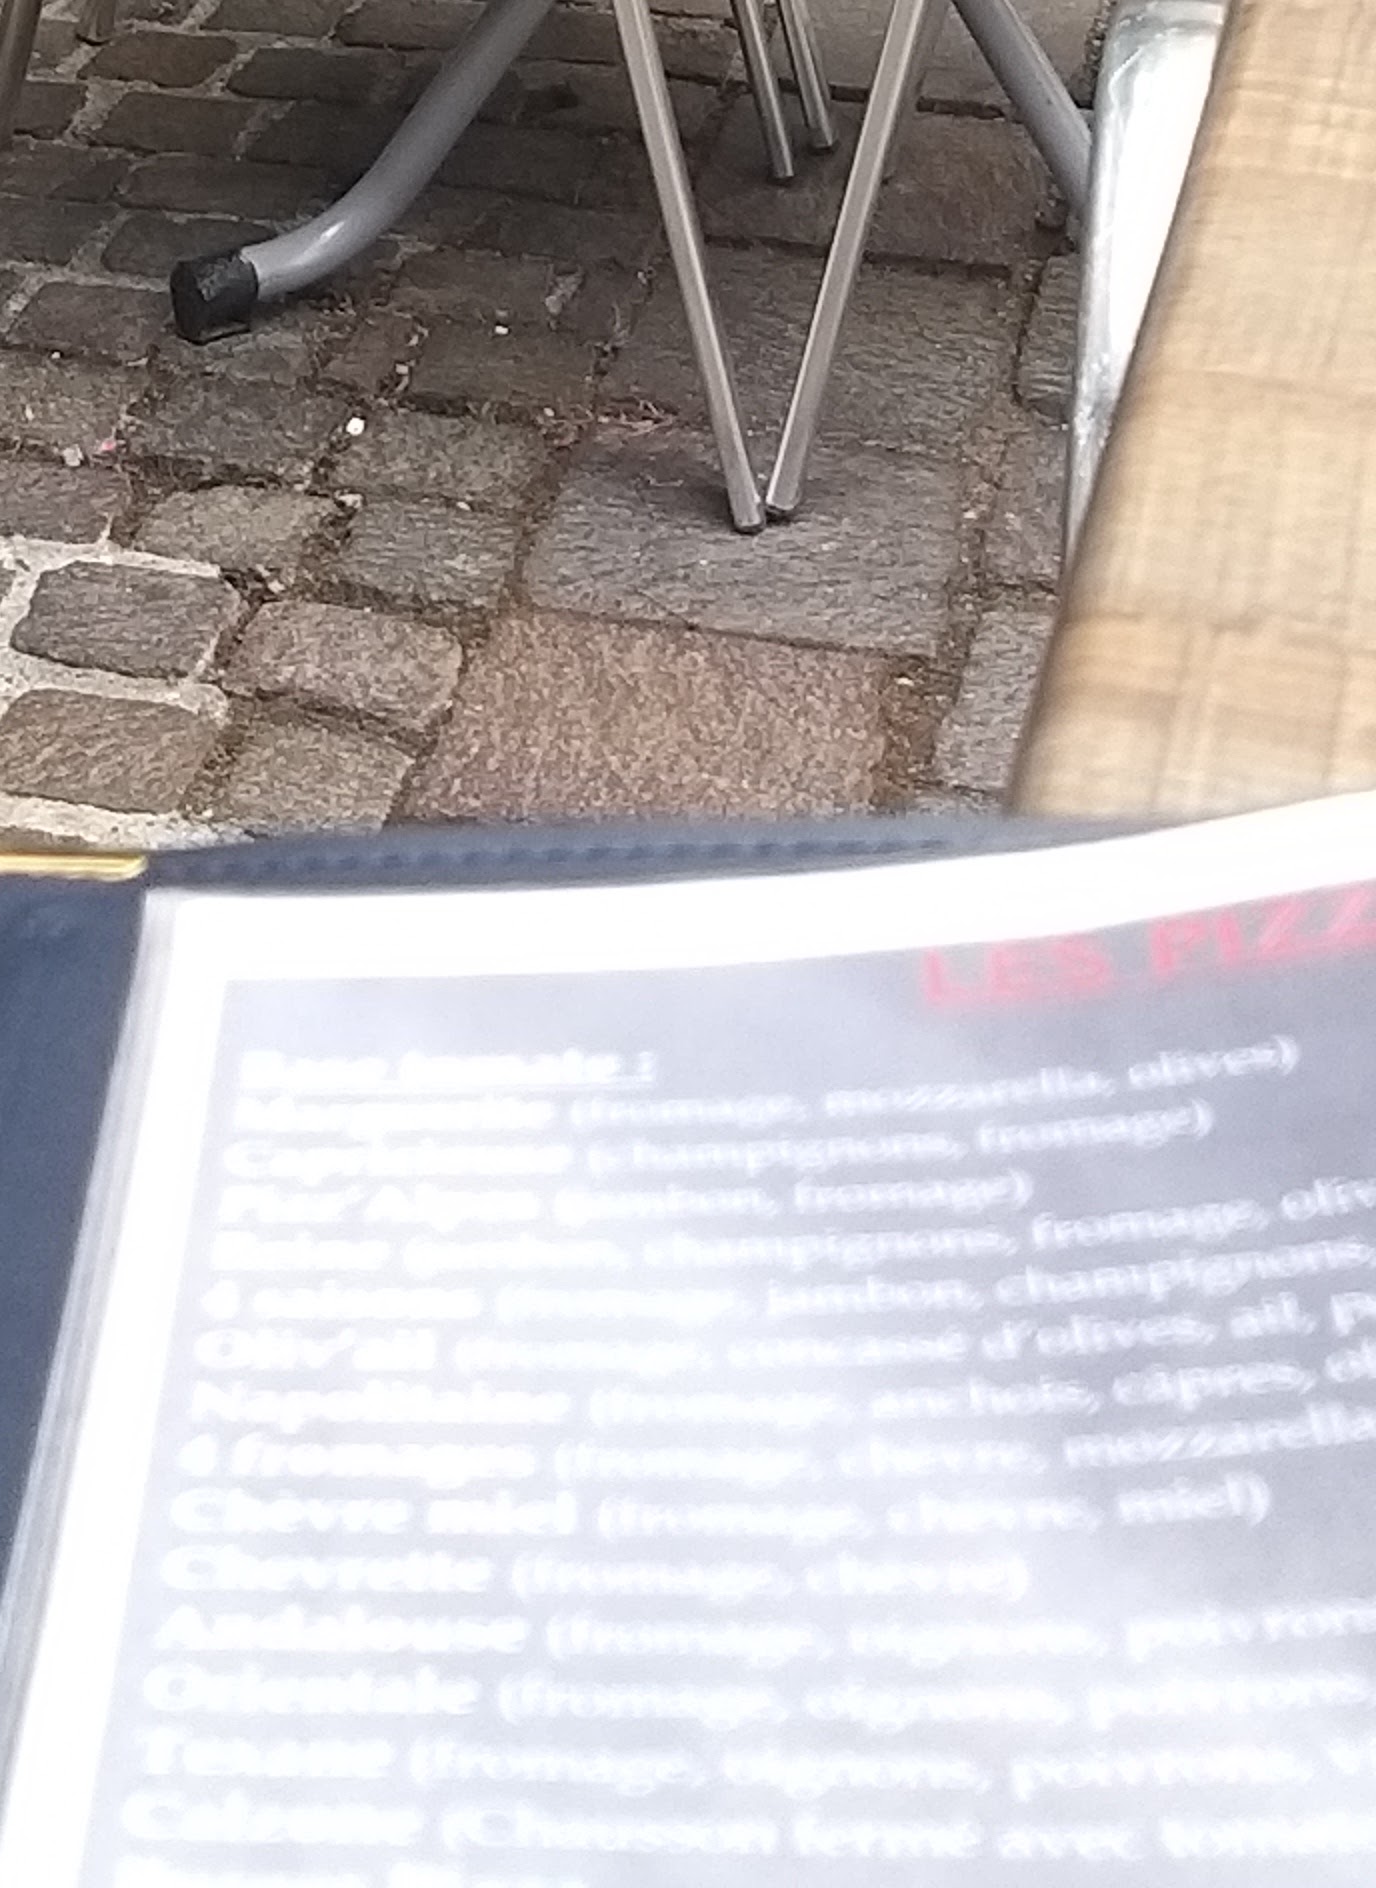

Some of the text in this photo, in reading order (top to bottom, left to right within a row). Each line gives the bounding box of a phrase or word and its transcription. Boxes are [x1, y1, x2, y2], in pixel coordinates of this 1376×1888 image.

[922, 883, 1376, 1008] LES PIZZ
[824, 1065, 1118, 1117] mozzarella,
[1129, 1033, 1301, 1088] olives)
[977, 1096, 1215, 1156] fromage)
[794, 1166, 1033, 1214] fromage)
[1032, 1199, 1270, 1251] fromage,
[1281, 1178, 1376, 1222] oliv
[981, 1314, 1219, 1361] d'olives,
[1231, 1291, 1317, 1338] ail,
[1117, 1471, 1273, 1527] miel)
